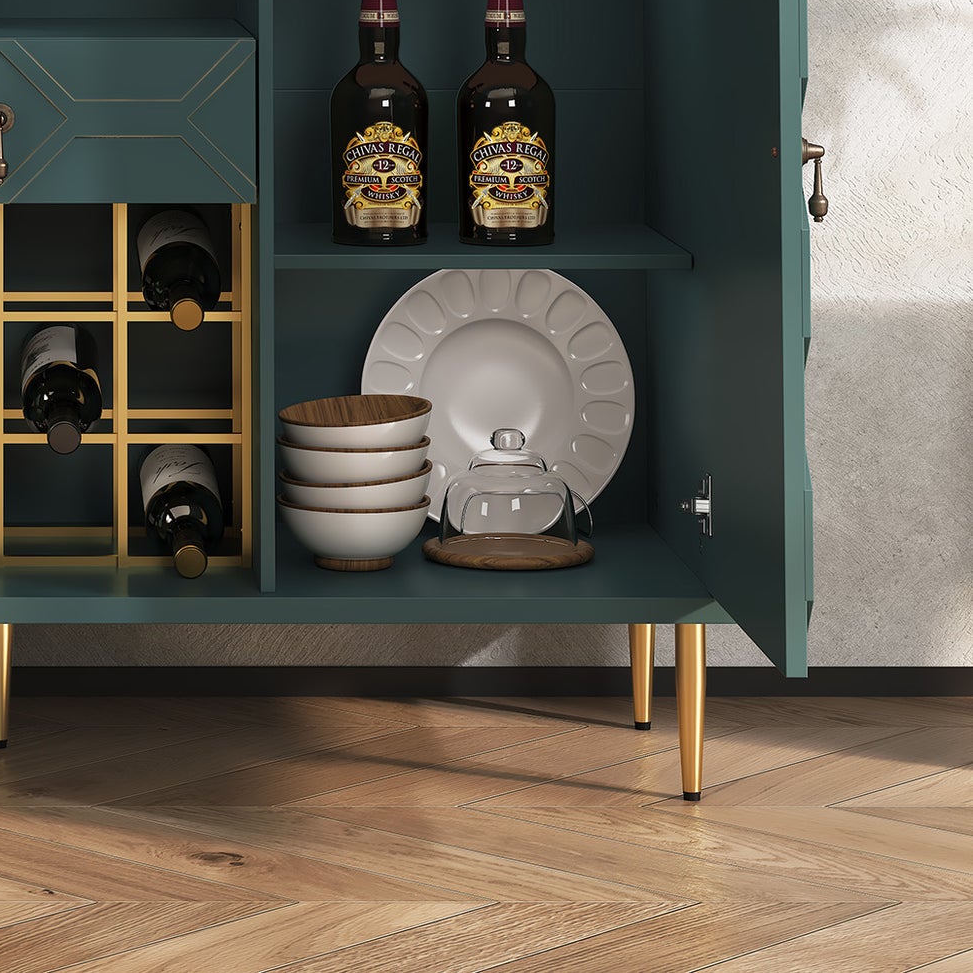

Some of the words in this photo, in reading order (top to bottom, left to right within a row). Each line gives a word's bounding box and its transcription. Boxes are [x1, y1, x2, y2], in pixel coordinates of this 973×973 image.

[346, 143, 384, 163] CHIVAS
[388, 143, 420, 163] REGAL
[473, 143, 512, 163] CHIVAS
[516, 143, 547, 163] REGAL
[378, 160, 389, 170] 12
[506, 160, 517, 170] 12
[390, 175, 419, 183] SCOTCH
[474, 175, 508, 183] PREMIUM
[518, 175, 546, 183] SCOTCH
[367, 190, 401, 200] WHISKY
[495, 190, 528, 200] WHISKY
